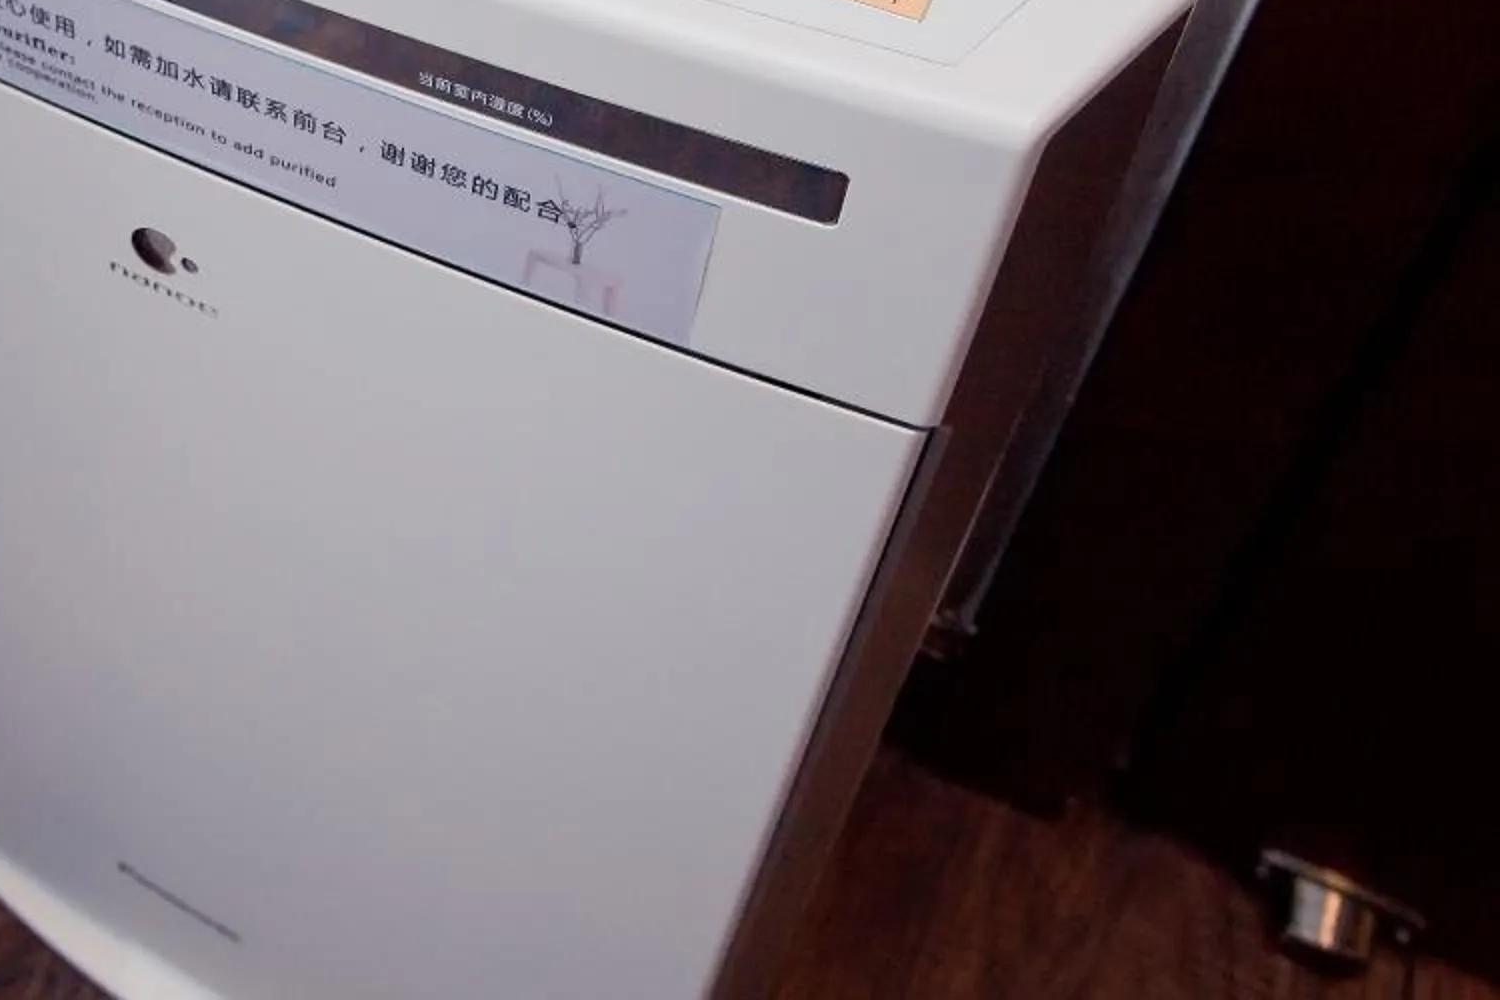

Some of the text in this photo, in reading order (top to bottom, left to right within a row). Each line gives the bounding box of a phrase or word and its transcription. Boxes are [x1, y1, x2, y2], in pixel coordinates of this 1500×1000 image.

[40, 59, 95, 91] contact
[101, 84, 125, 102] the
[131, 99, 205, 135] reception
[211, 129, 227, 145] to
[233, 140, 264, 160] add
[269, 155, 338, 188] purified
